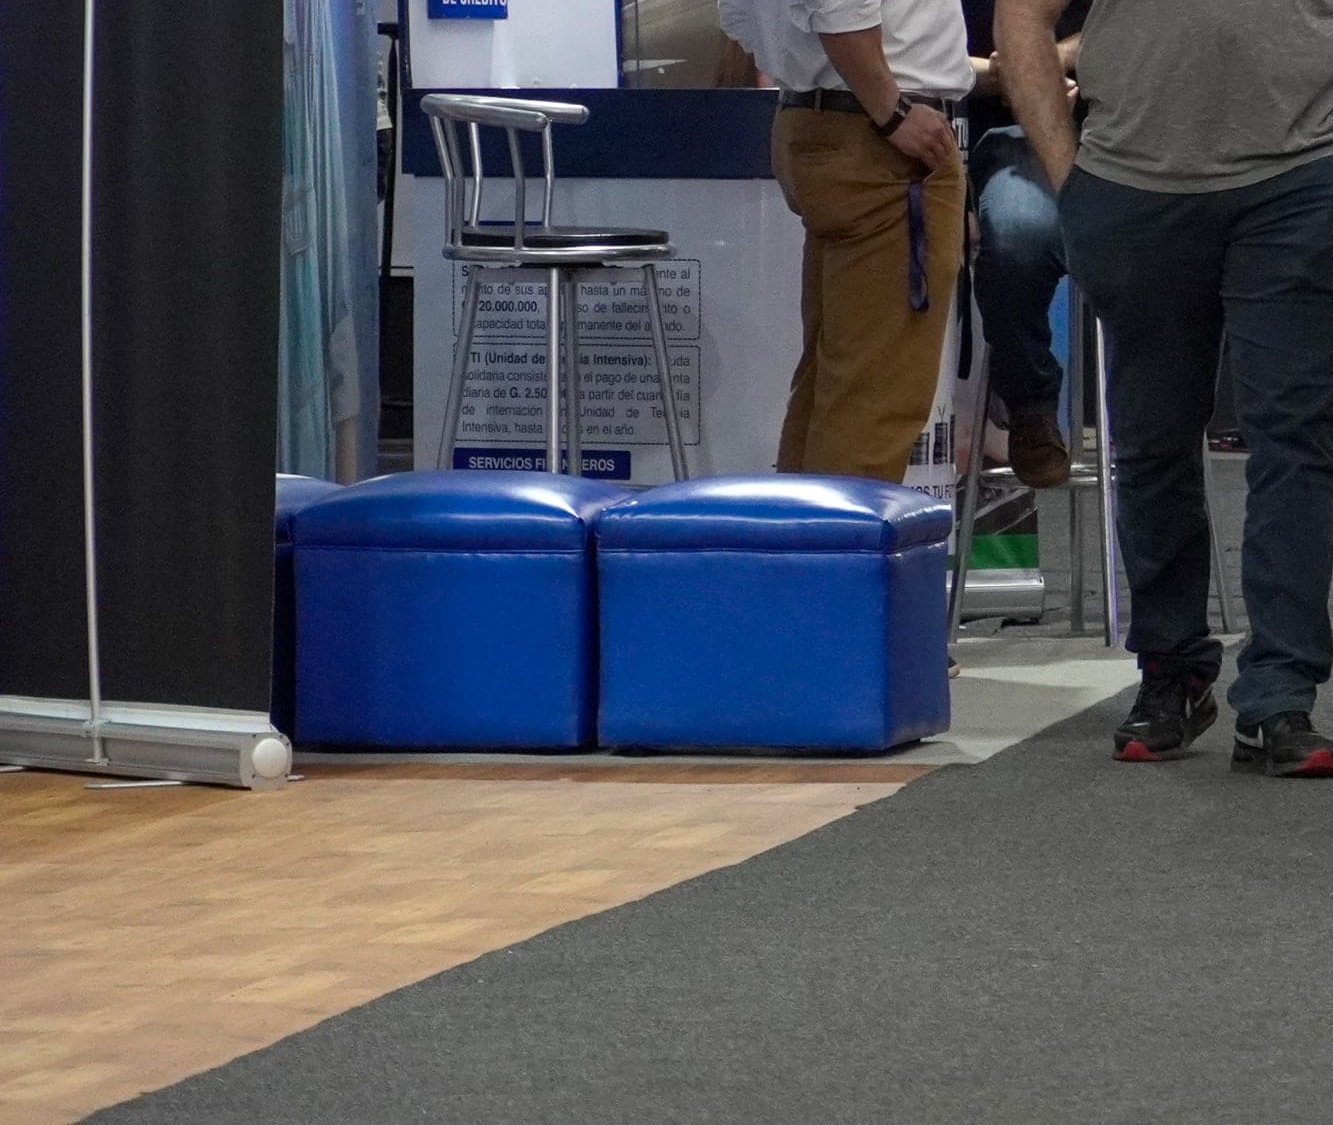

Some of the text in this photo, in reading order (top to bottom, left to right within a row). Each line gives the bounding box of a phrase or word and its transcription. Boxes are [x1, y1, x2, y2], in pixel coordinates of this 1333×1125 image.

[497, 282, 512, 296] de
[515, 285, 533, 295] sus
[581, 284, 608, 296] hasta
[676, 283, 691, 296] de
[593, 301, 606, 314] de
[484, 352, 528, 367] (Unidad
[531, 353, 545, 365] de
[595, 374, 621, 387] pago
[624, 372, 637, 384] de
[493, 387, 506, 399] de
[509, 386, 521, 400] G.
[588, 388, 614, 403] partir
[462, 403, 475, 415] de
[625, 407, 640, 419] de
[514, 422, 543, 434] hasta
[586, 427, 599, 436] en
[602, 423, 612, 436] el
[468, 456, 532, 470] SERVICIOS
